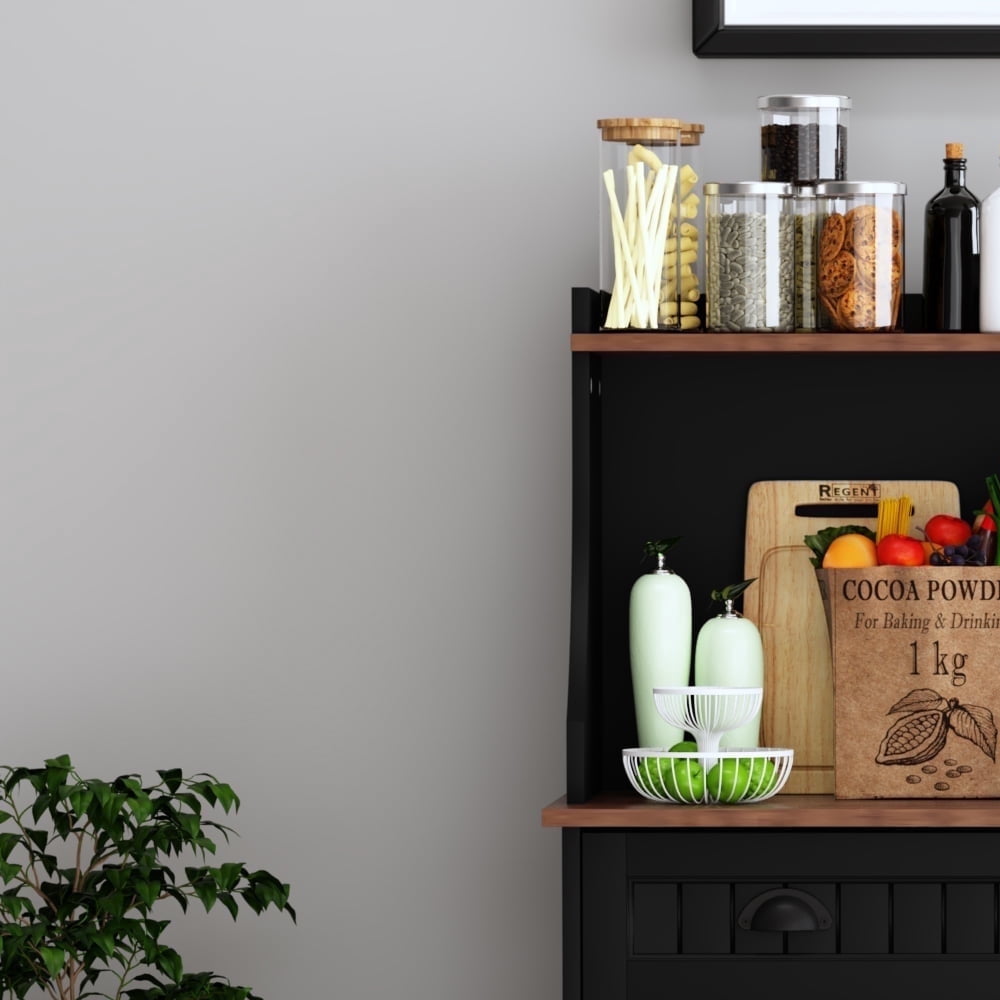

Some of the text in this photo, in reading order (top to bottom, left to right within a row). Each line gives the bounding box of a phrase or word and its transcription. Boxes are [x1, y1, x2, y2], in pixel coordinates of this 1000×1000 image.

[819, 484, 878, 497] REGENT
[842, 579, 920, 601] COCOA
[855, 612, 879, 630] For
[883, 612, 931, 634] Baking
[935, 612, 947, 630] &
[909, 640, 969, 687] 1 kg
